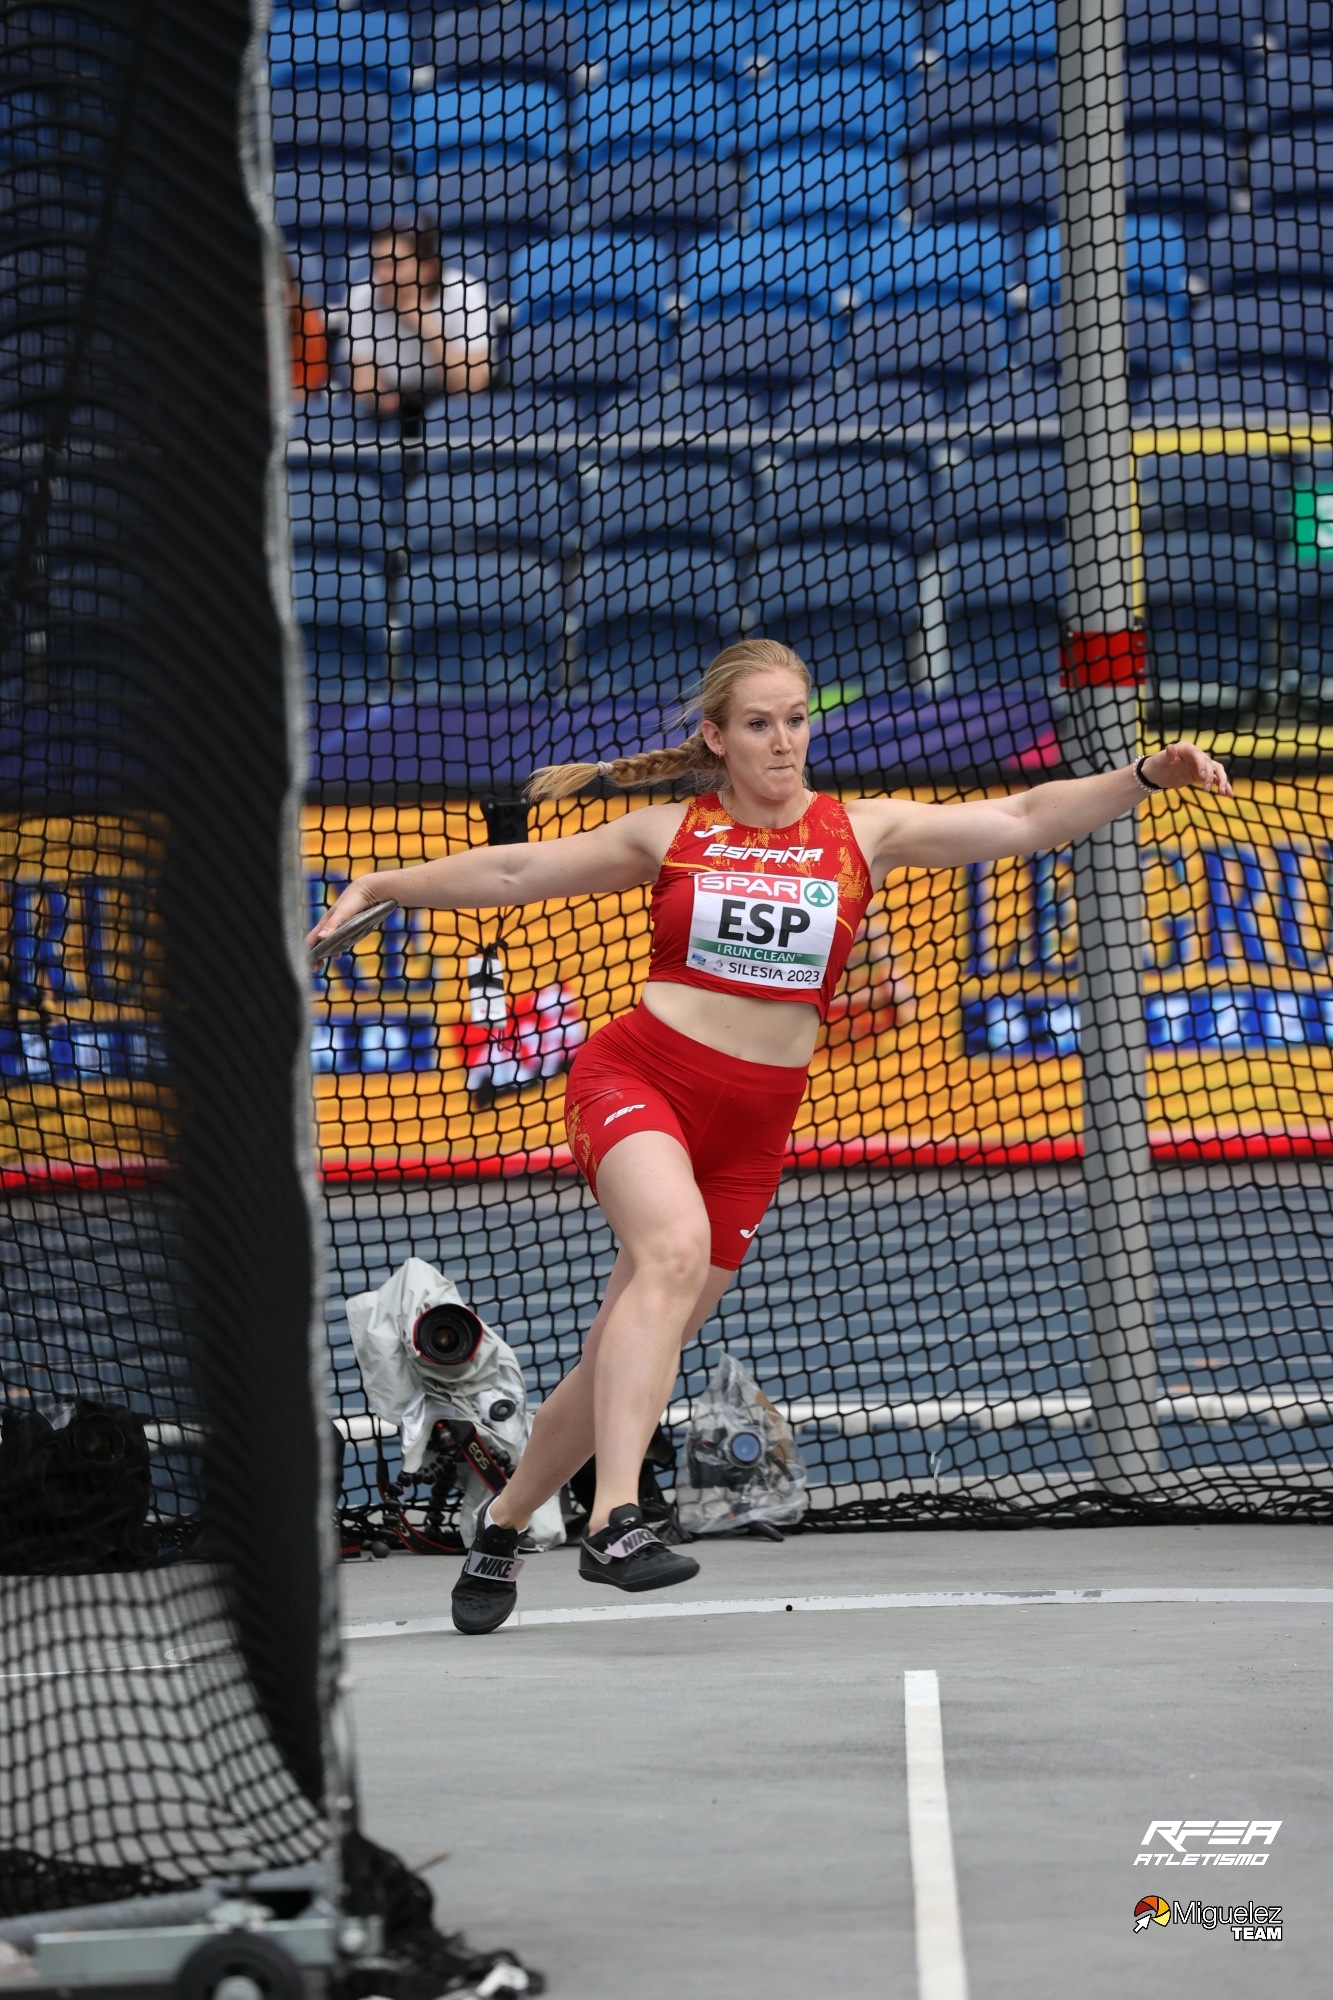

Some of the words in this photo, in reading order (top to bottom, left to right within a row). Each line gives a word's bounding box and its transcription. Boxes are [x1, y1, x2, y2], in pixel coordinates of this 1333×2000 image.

[703, 843, 823, 863] ESPAÑA
[701, 876, 798, 900] SPAR
[717, 898, 811, 948] ESP
[716, 944, 721, 953] I
[723, 945, 752, 959] RUN
[728, 961, 784, 981] SILESIA
[786, 969, 820, 983] 2023
[621, 1528, 657, 1553] NIKE
[474, 1556, 514, 1579] NIKE
